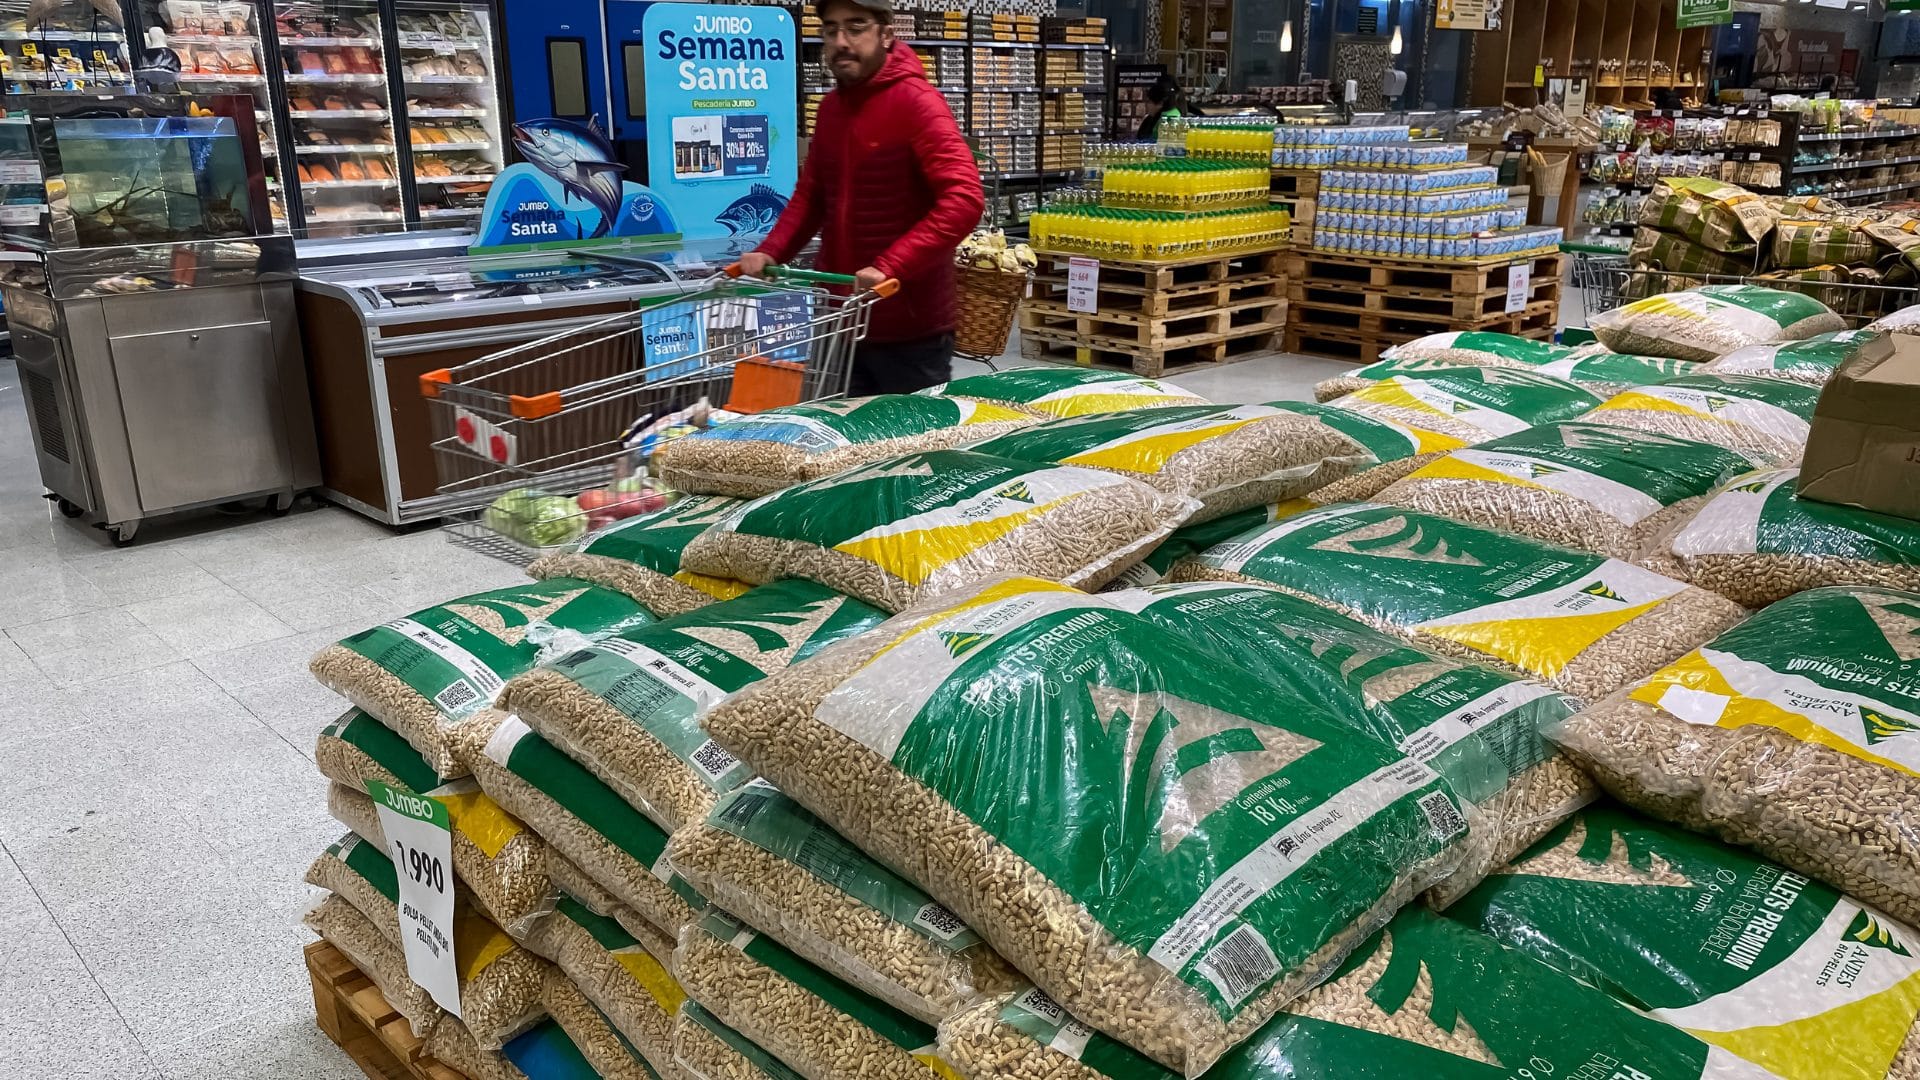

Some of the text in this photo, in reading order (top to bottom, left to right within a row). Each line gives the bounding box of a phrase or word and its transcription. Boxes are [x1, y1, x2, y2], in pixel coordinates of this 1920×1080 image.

[693, 15, 753, 34] JUMBO
[658, 29, 784, 61] Semana
[679, 60, 768, 90] Santa
[501, 208, 566, 224] Semana
[518, 201, 549, 211] JUMBO
[511, 221, 558, 236] Santa
[646, 331, 695, 346] Semana
[1470, 390, 1508, 407] PELLETS
[1550, 451, 1602, 468] PELLETS
[964, 466, 1013, 485] PELLETS
[913, 482, 968, 511] PREMIUM
[968, 499, 1004, 518] ANDES
[1494, 560, 1574, 598] PELLETS PREMIUM
[1567, 594, 1596, 611] ANDES
[972, 601, 1018, 631] ANDES
[1029, 611, 1109, 652] PREMIUM
[691, 642, 730, 664] Contenido Neto
[1043, 620, 1126, 666] RENOVABLE
[674, 646, 703, 667] 18 Kg.
[1061, 671, 1074, 683] 6
[1785, 658, 1883, 687] PREMIUM
[1412, 675, 1458, 699] Contenido Neto
[1425, 692, 1451, 708] 18
[1440, 688, 1469, 704] Kg.
[1783, 688, 1854, 708] BIO PELLETS
[1471, 709, 1486, 720] Una
[1788, 699, 1857, 717] ANDES
[385, 787, 433, 819] JUMBO
[1236, 775, 1291, 810] Contenido Neto
[1248, 805, 1276, 826] 18
[1270, 796, 1298, 815] Kg.
[1294, 809, 1344, 845] Una Empresa JCE
[1708, 883, 1724, 893] 6
[1690, 892, 1714, 913] mm.
[403, 902, 419, 922] BOLSA
[419, 913, 433, 933] PELLET
[1698, 899, 1756, 960] RENOVABLE
[1723, 907, 1784, 971] PREMIUM
[1816, 943, 1849, 988] BIO PELLETS
[1836, 945, 1871, 989] ANDES
